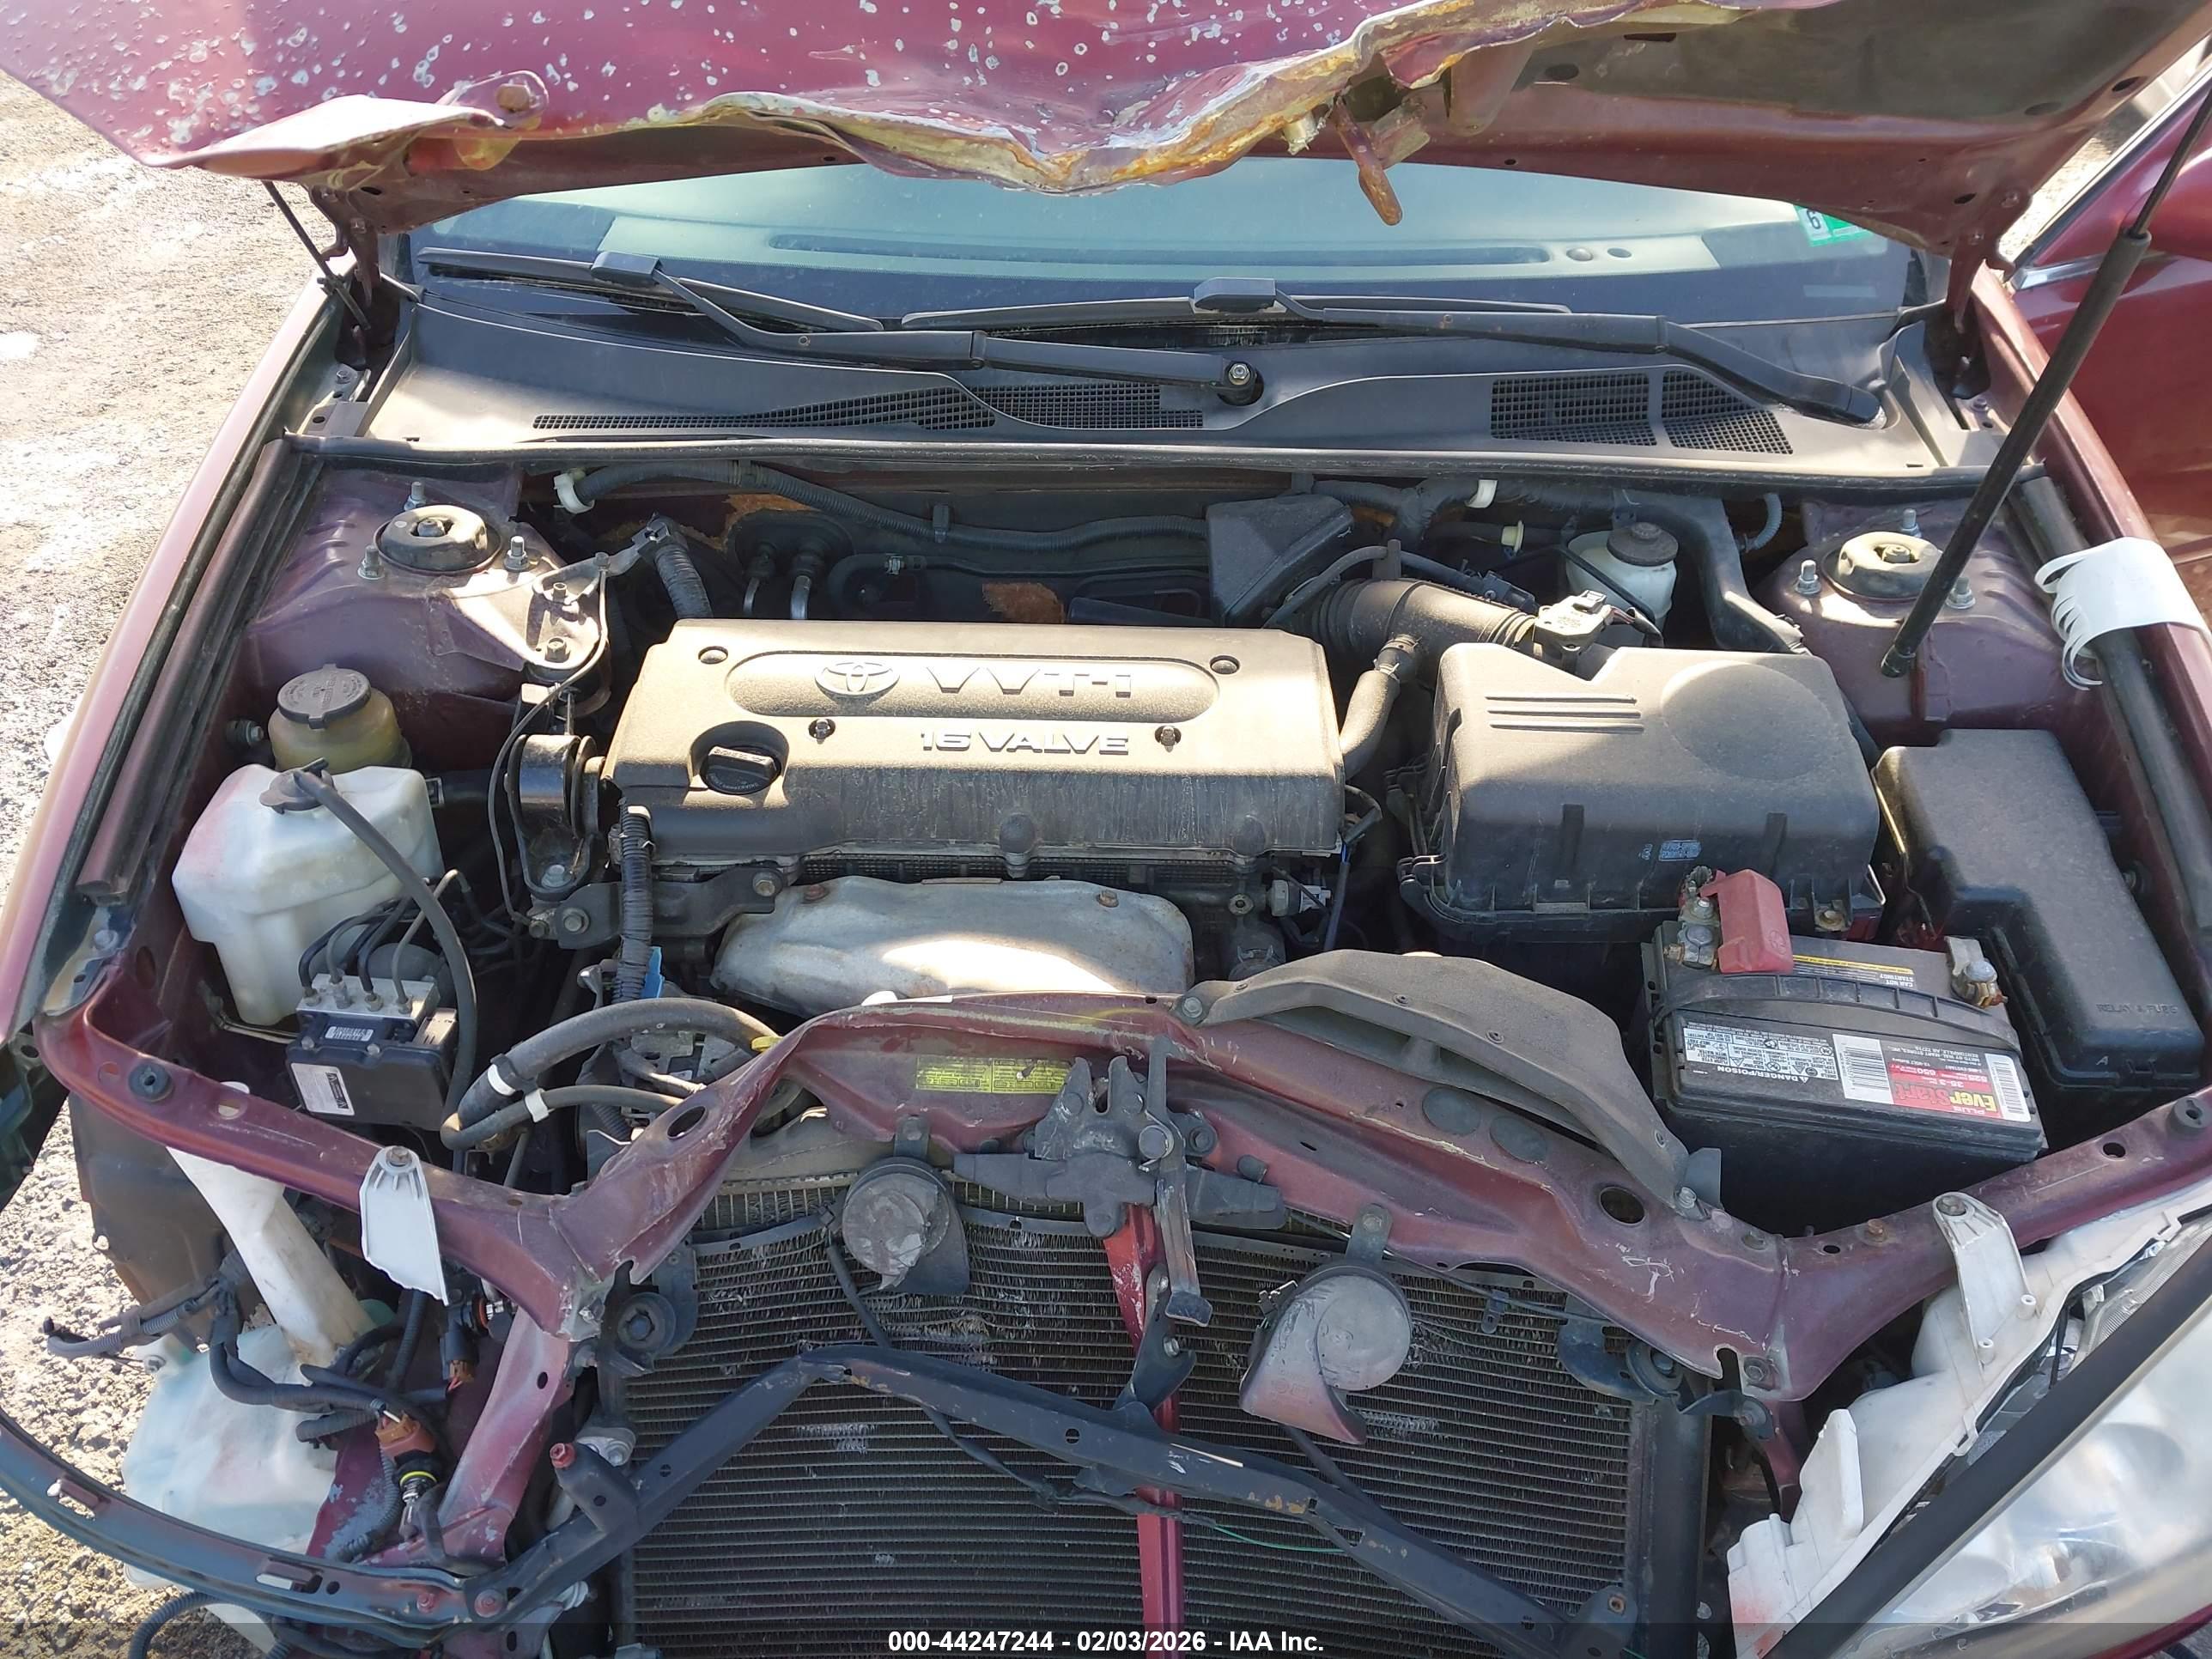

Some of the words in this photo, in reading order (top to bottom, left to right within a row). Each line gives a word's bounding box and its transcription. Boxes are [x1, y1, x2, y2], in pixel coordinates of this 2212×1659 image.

[1807, 210, 1821, 229] 6
[921, 731, 971, 751] 16
[979, 732, 1128, 755] VALVE
[1717, 1066, 1801, 1081] DANGER/POISON
